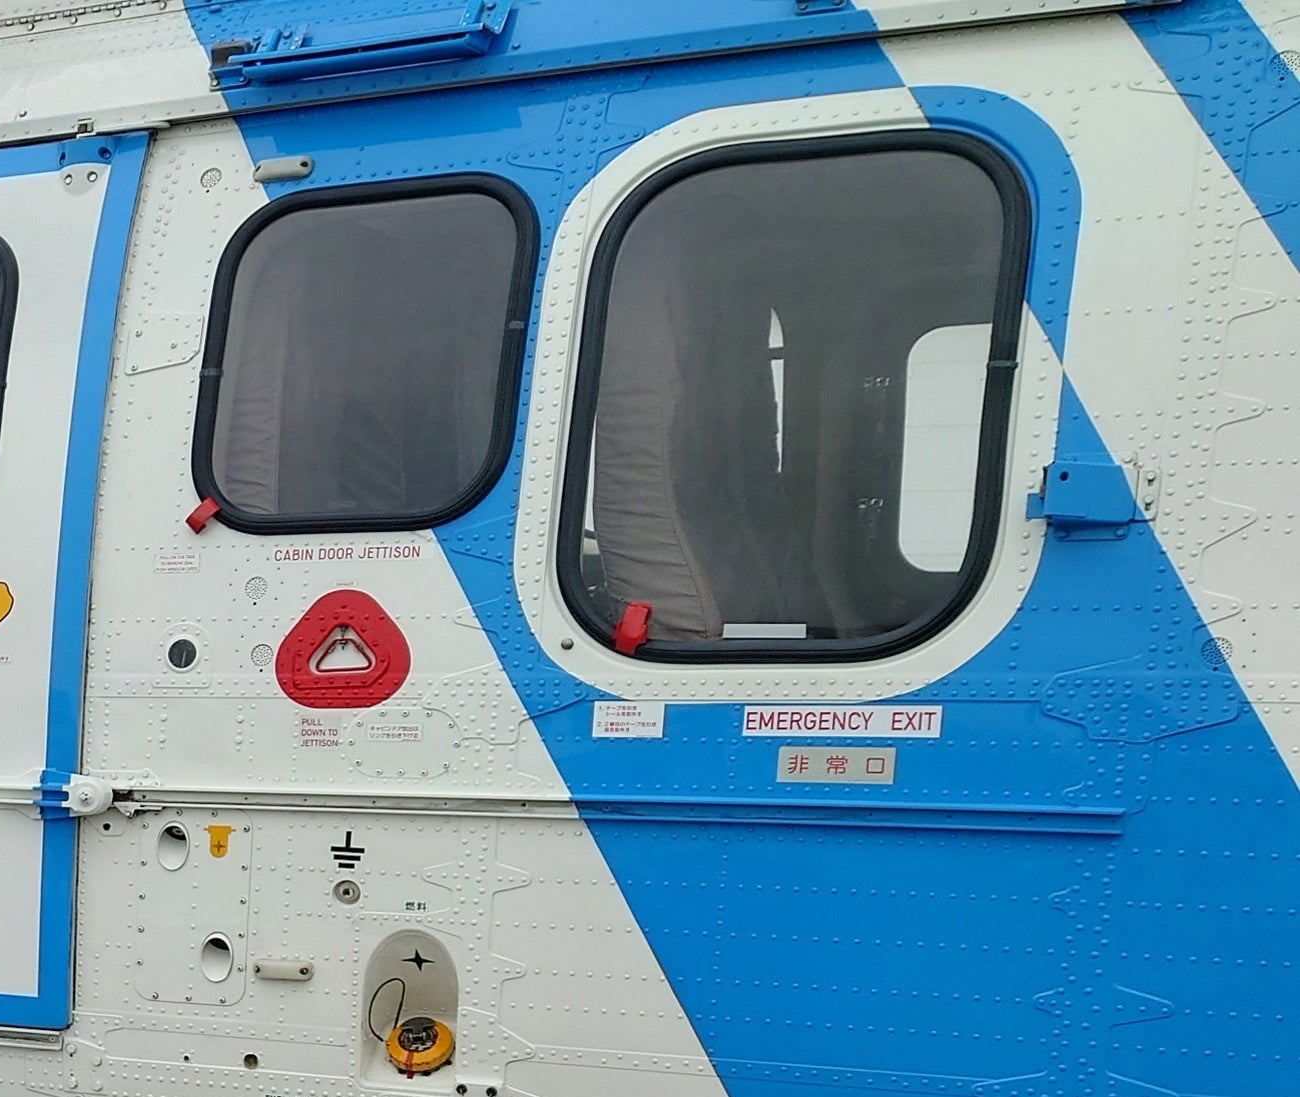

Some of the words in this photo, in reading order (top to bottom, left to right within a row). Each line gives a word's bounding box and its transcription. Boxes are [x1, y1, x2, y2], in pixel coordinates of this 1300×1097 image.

[274, 549, 314, 562] CABIN
[318, 547, 354, 560] DOOR
[357, 545, 421, 560] JETTISON
[745, 711, 874, 731] EMERGENCY
[890, 711, 937, 731] EXIT
[301, 729, 326, 737] DOWN
[328, 728, 338, 736] TO
[301, 738, 339, 747] JETTISON
[787, 754, 886, 775] 非常口
